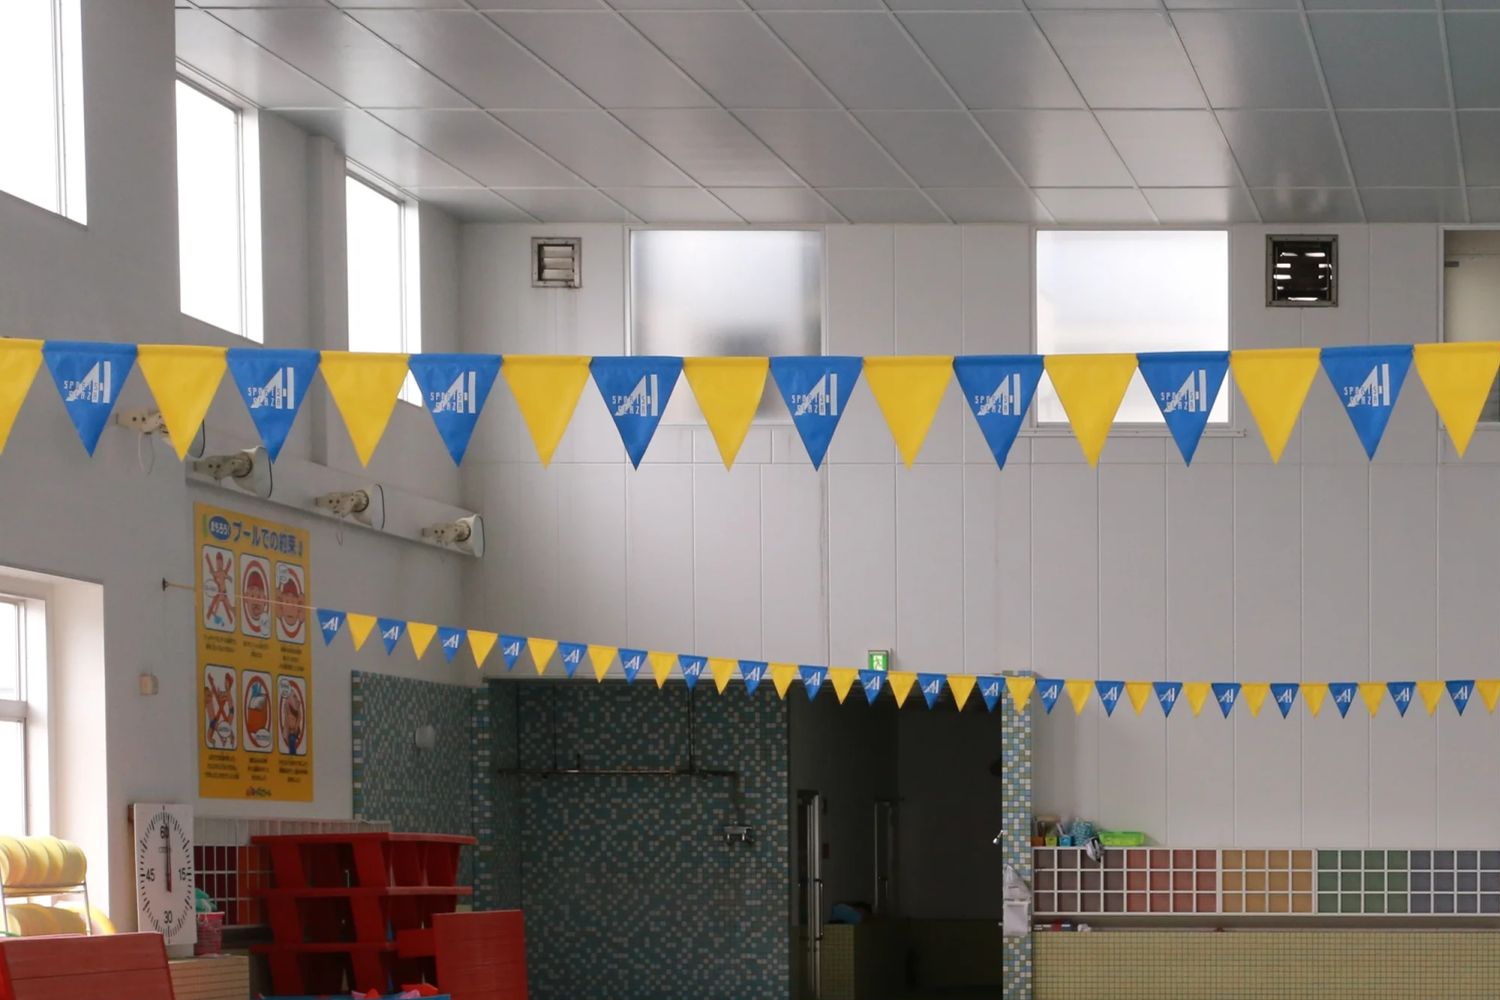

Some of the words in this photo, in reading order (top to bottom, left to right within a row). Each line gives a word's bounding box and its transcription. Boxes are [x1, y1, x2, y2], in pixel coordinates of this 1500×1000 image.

[145, 868, 155, 882] 45
[178, 867, 186, 881] 15
[164, 910, 173, 924] 30
